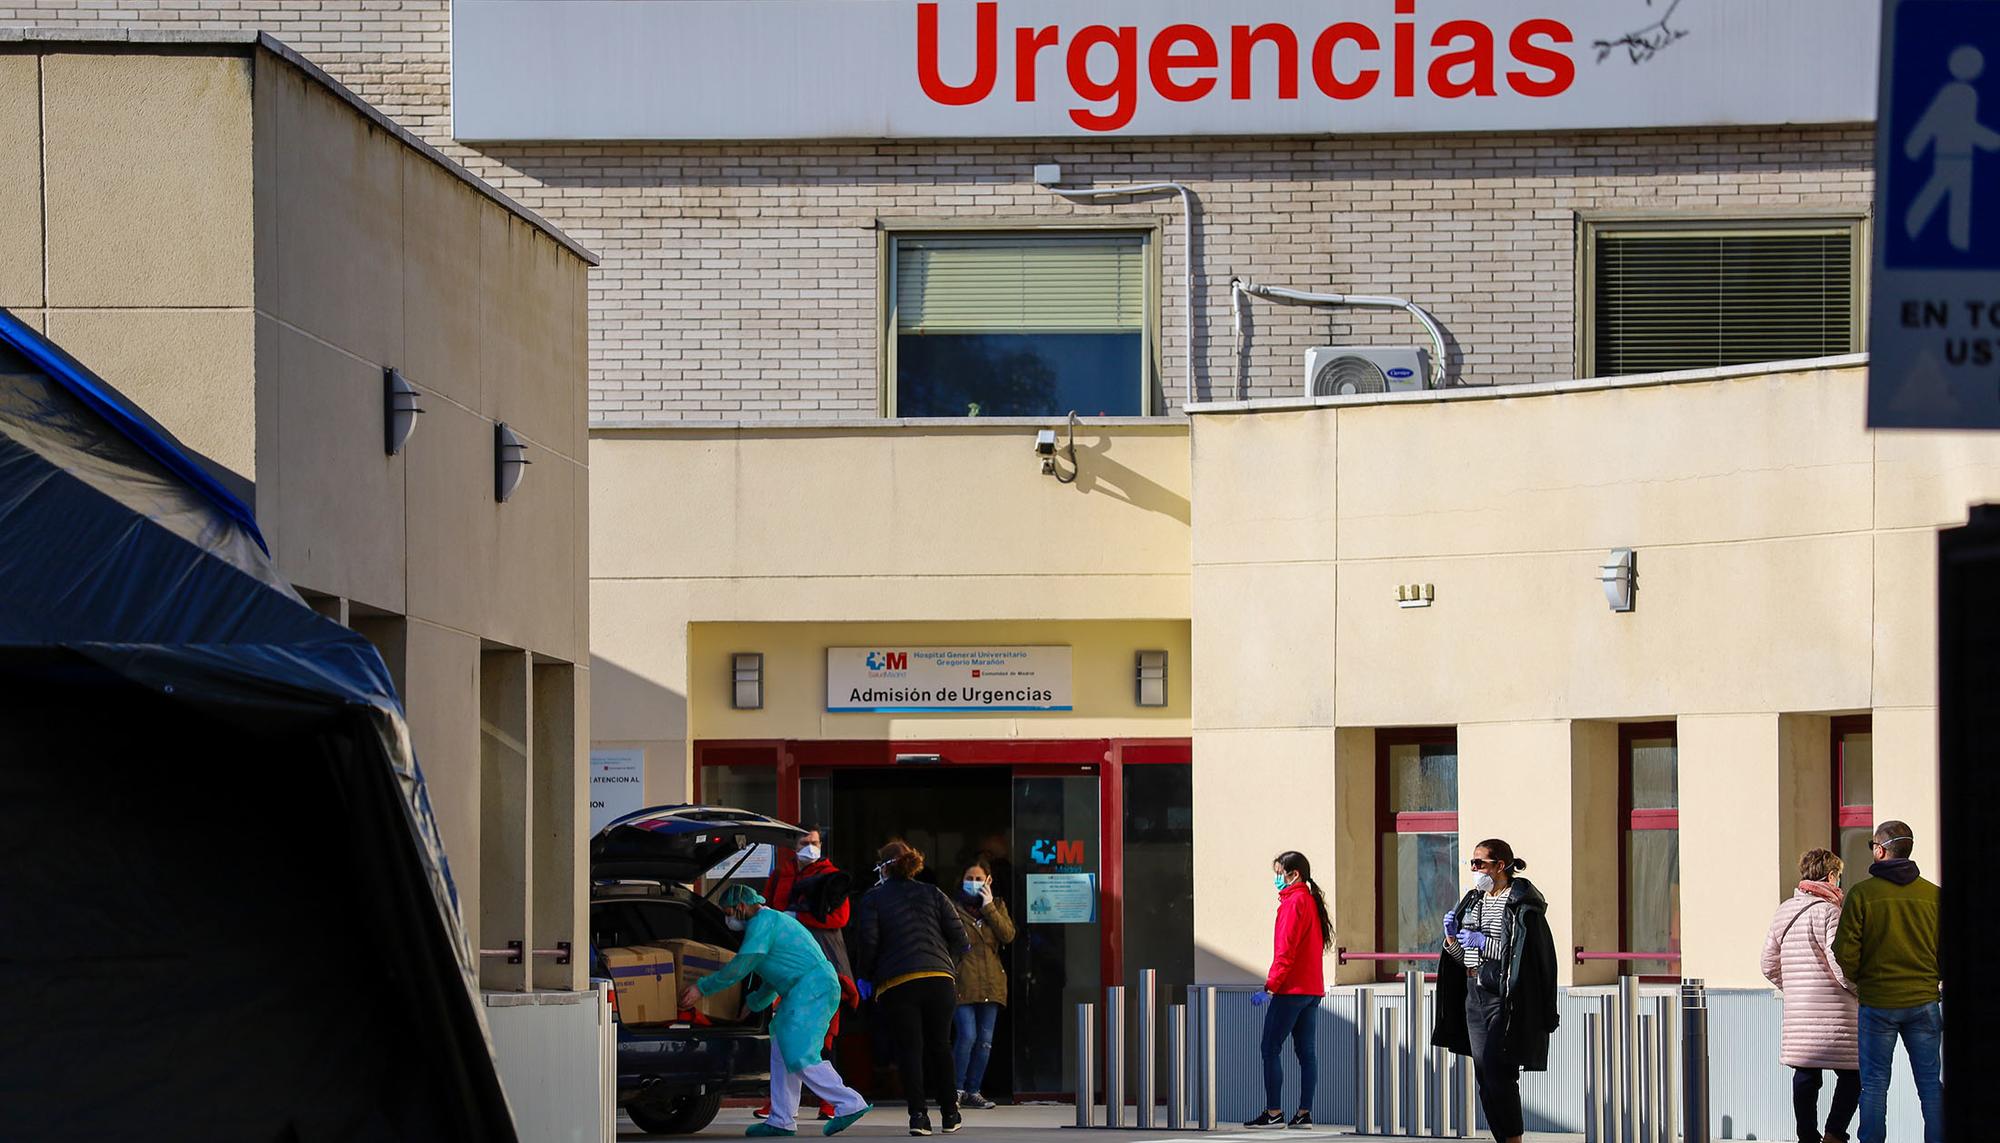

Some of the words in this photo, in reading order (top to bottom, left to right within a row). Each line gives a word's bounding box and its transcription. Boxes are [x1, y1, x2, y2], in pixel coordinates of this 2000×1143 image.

[916, 0, 1576, 132] Urgencias
[1901, 300, 1948, 329] EN
[1945, 338, 2000, 367] US
[914, 651, 946, 659] Hospital
[947, 651, 976, 659] General
[979, 650, 1027, 659] Universitario
[936, 658, 970, 667] Gregorio
[971, 658, 1005, 666] Marañón
[849, 687, 931, 702] Admisión
[936, 687, 957, 702] de
[962, 687, 1052, 704] Urgencias
[593, 776, 629, 784] ATENCION
[630, 776, 640, 784] AL
